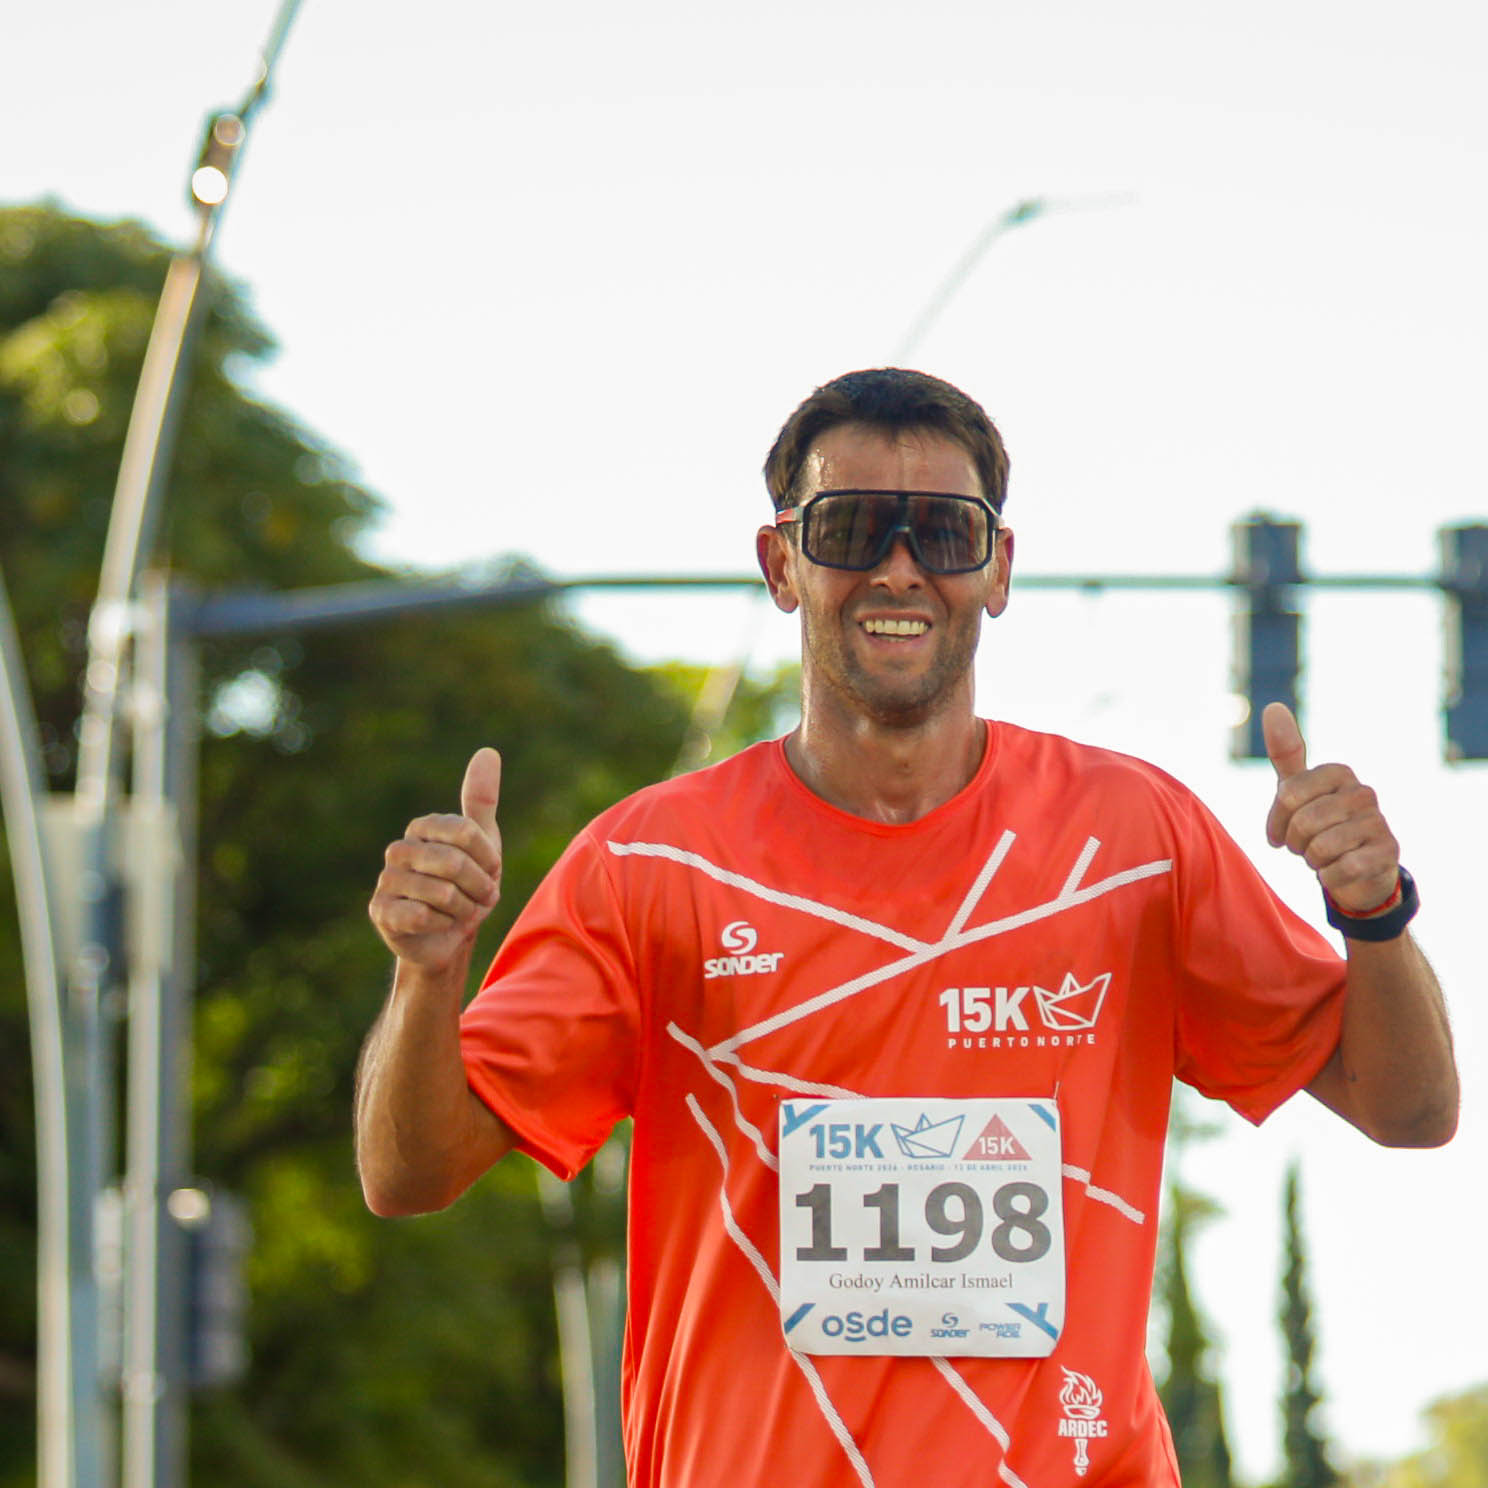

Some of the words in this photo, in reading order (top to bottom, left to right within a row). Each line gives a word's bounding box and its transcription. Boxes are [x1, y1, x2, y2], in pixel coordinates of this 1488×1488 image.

[939, 987, 1030, 1033] 15K
[947, 1036, 1030, 1049] PUERTO
[1037, 1033, 1096, 1047] NORTE
[809, 1123, 885, 1160] 15K
[978, 1136, 1016, 1155] 15K
[795, 1181, 1052, 1263] 1198
[829, 1273, 883, 1292] Godoy
[889, 1272, 956, 1289] Amilcar
[962, 1272, 1013, 1289] Ismael
[821, 1308, 913, 1342] osde
[1057, 1418, 1108, 1437] ARDEC
